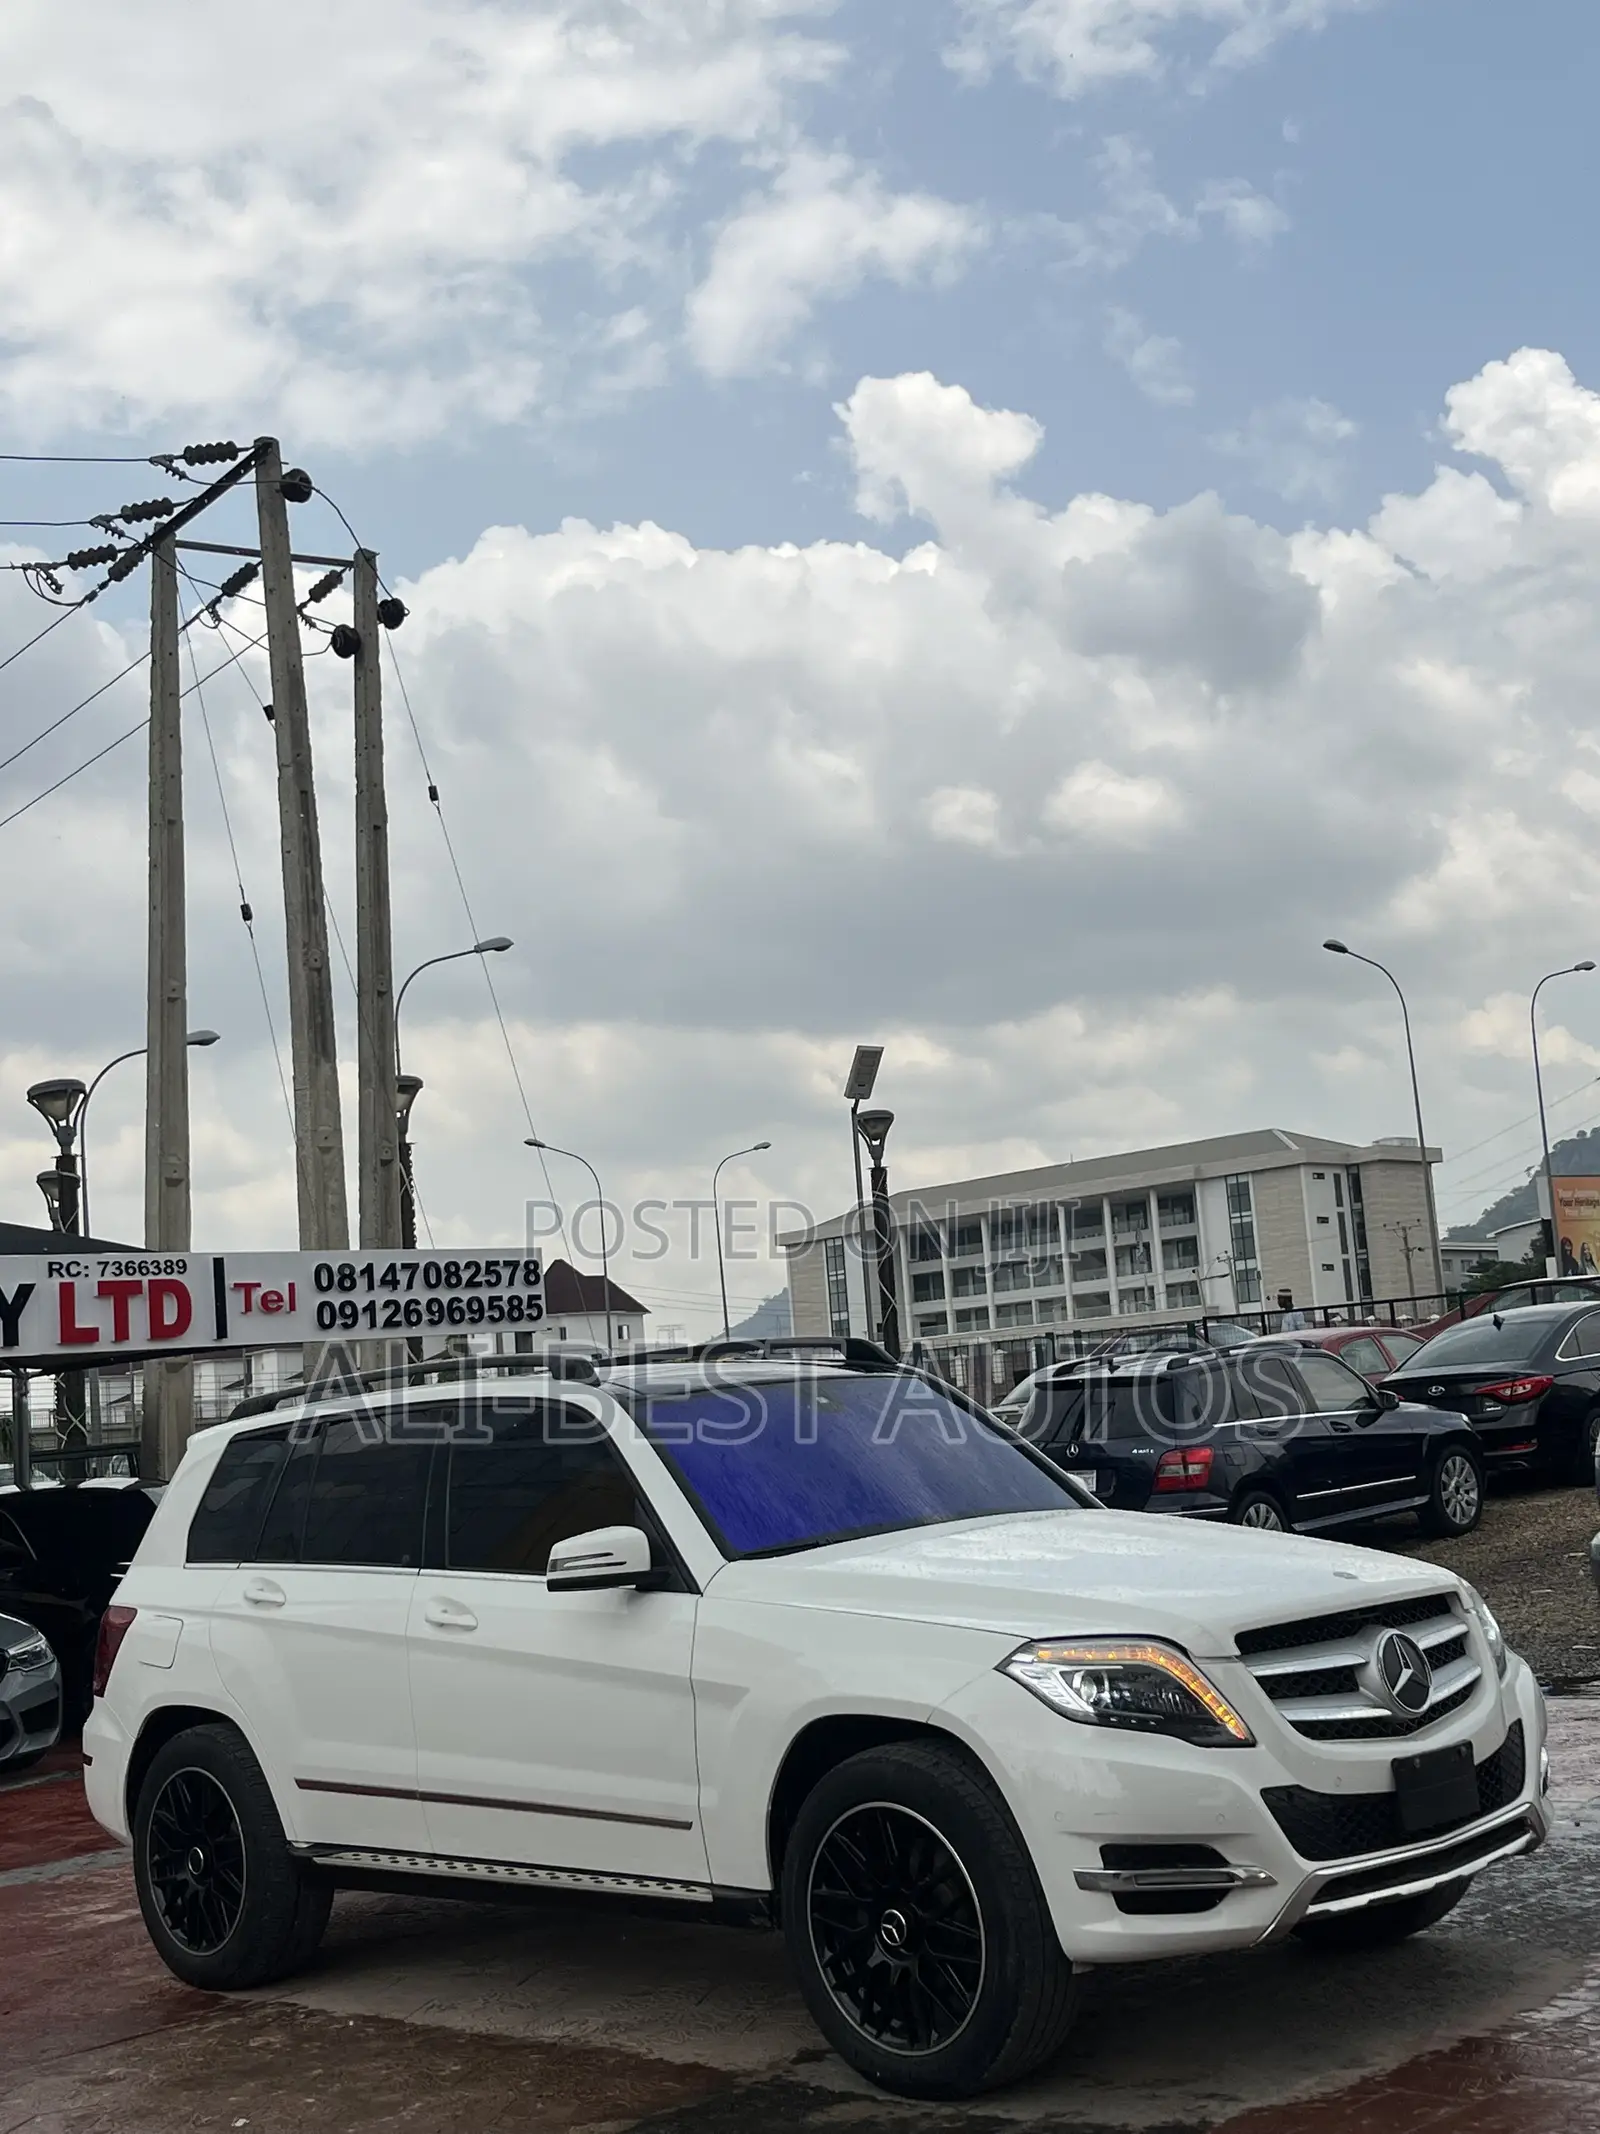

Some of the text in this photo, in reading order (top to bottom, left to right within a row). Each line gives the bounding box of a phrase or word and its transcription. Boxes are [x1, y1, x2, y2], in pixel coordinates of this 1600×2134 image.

[48, 1258, 188, 1278] RC: 7366389
[313, 1260, 541, 1292] 08147082578
[58, 1278, 192, 1344] LTD
[232, 1282, 296, 1314] Tel
[316, 1294, 544, 1329] 09126969585
